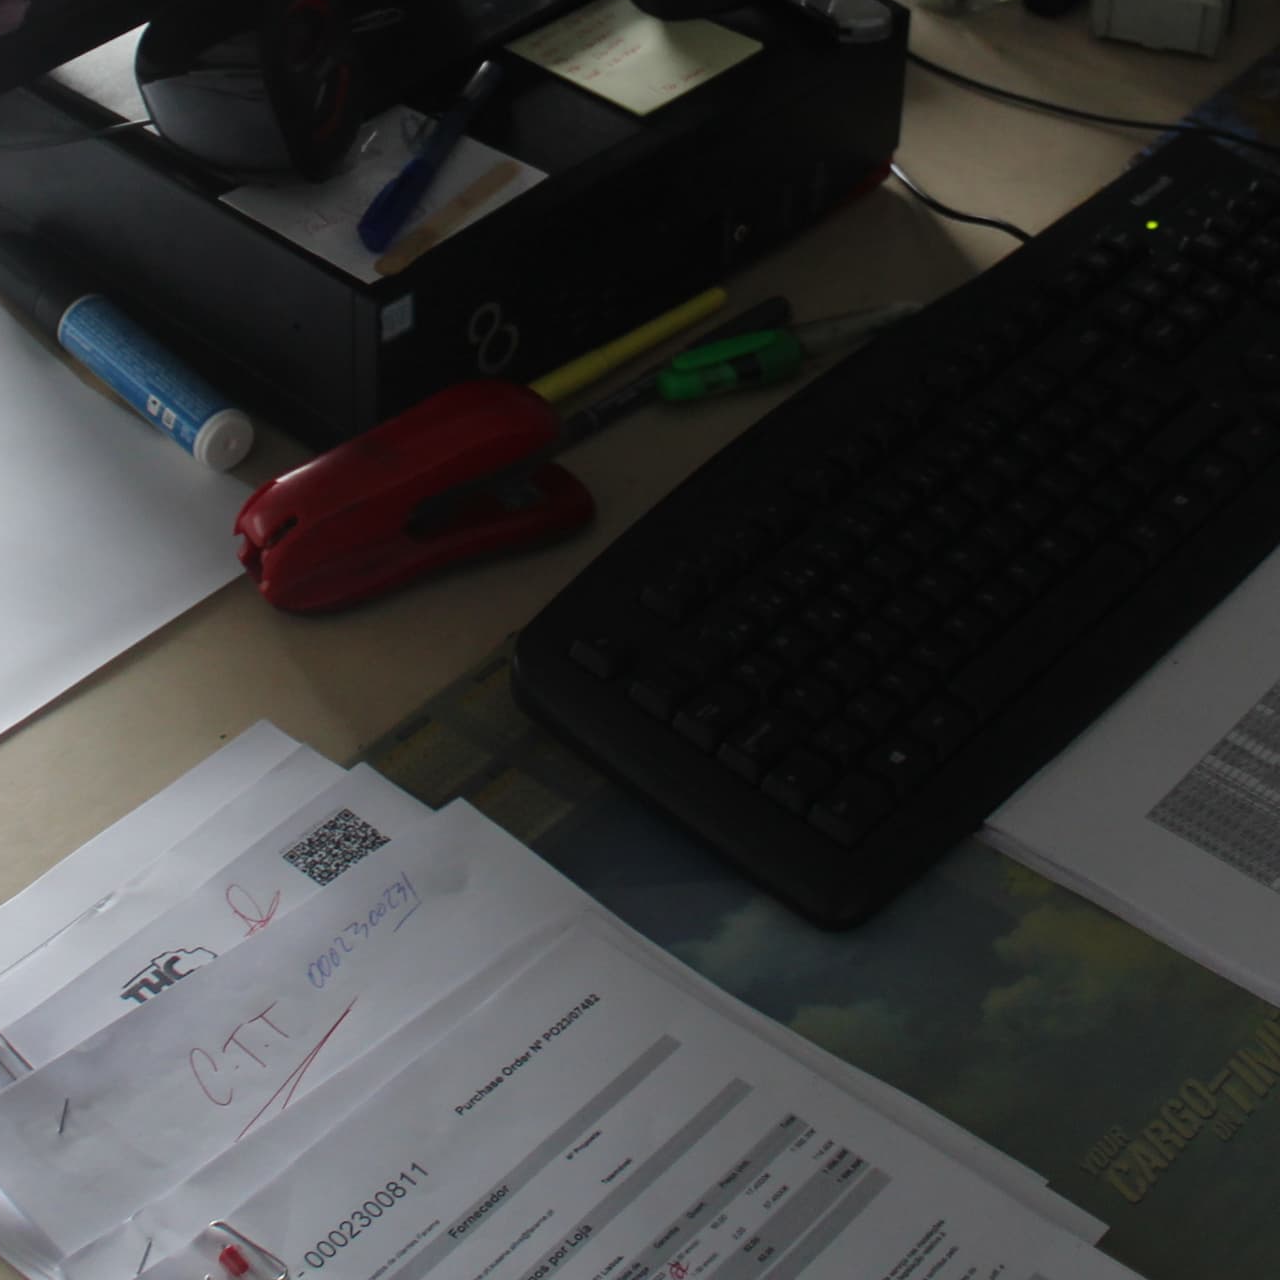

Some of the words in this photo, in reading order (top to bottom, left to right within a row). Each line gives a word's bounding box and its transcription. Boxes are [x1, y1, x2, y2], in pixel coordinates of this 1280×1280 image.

[454, 1073, 506, 1117] Purchase
[501, 1049, 531, 1077] Order
[1080, 1125, 1130, 1175] YOUR
[304, 1160, 431, 1271] 0002300811
[447, 1183, 511, 1241] Fornecedor
[548, 1242, 569, 1268] por
[564, 1222, 593, 1250] Loja
